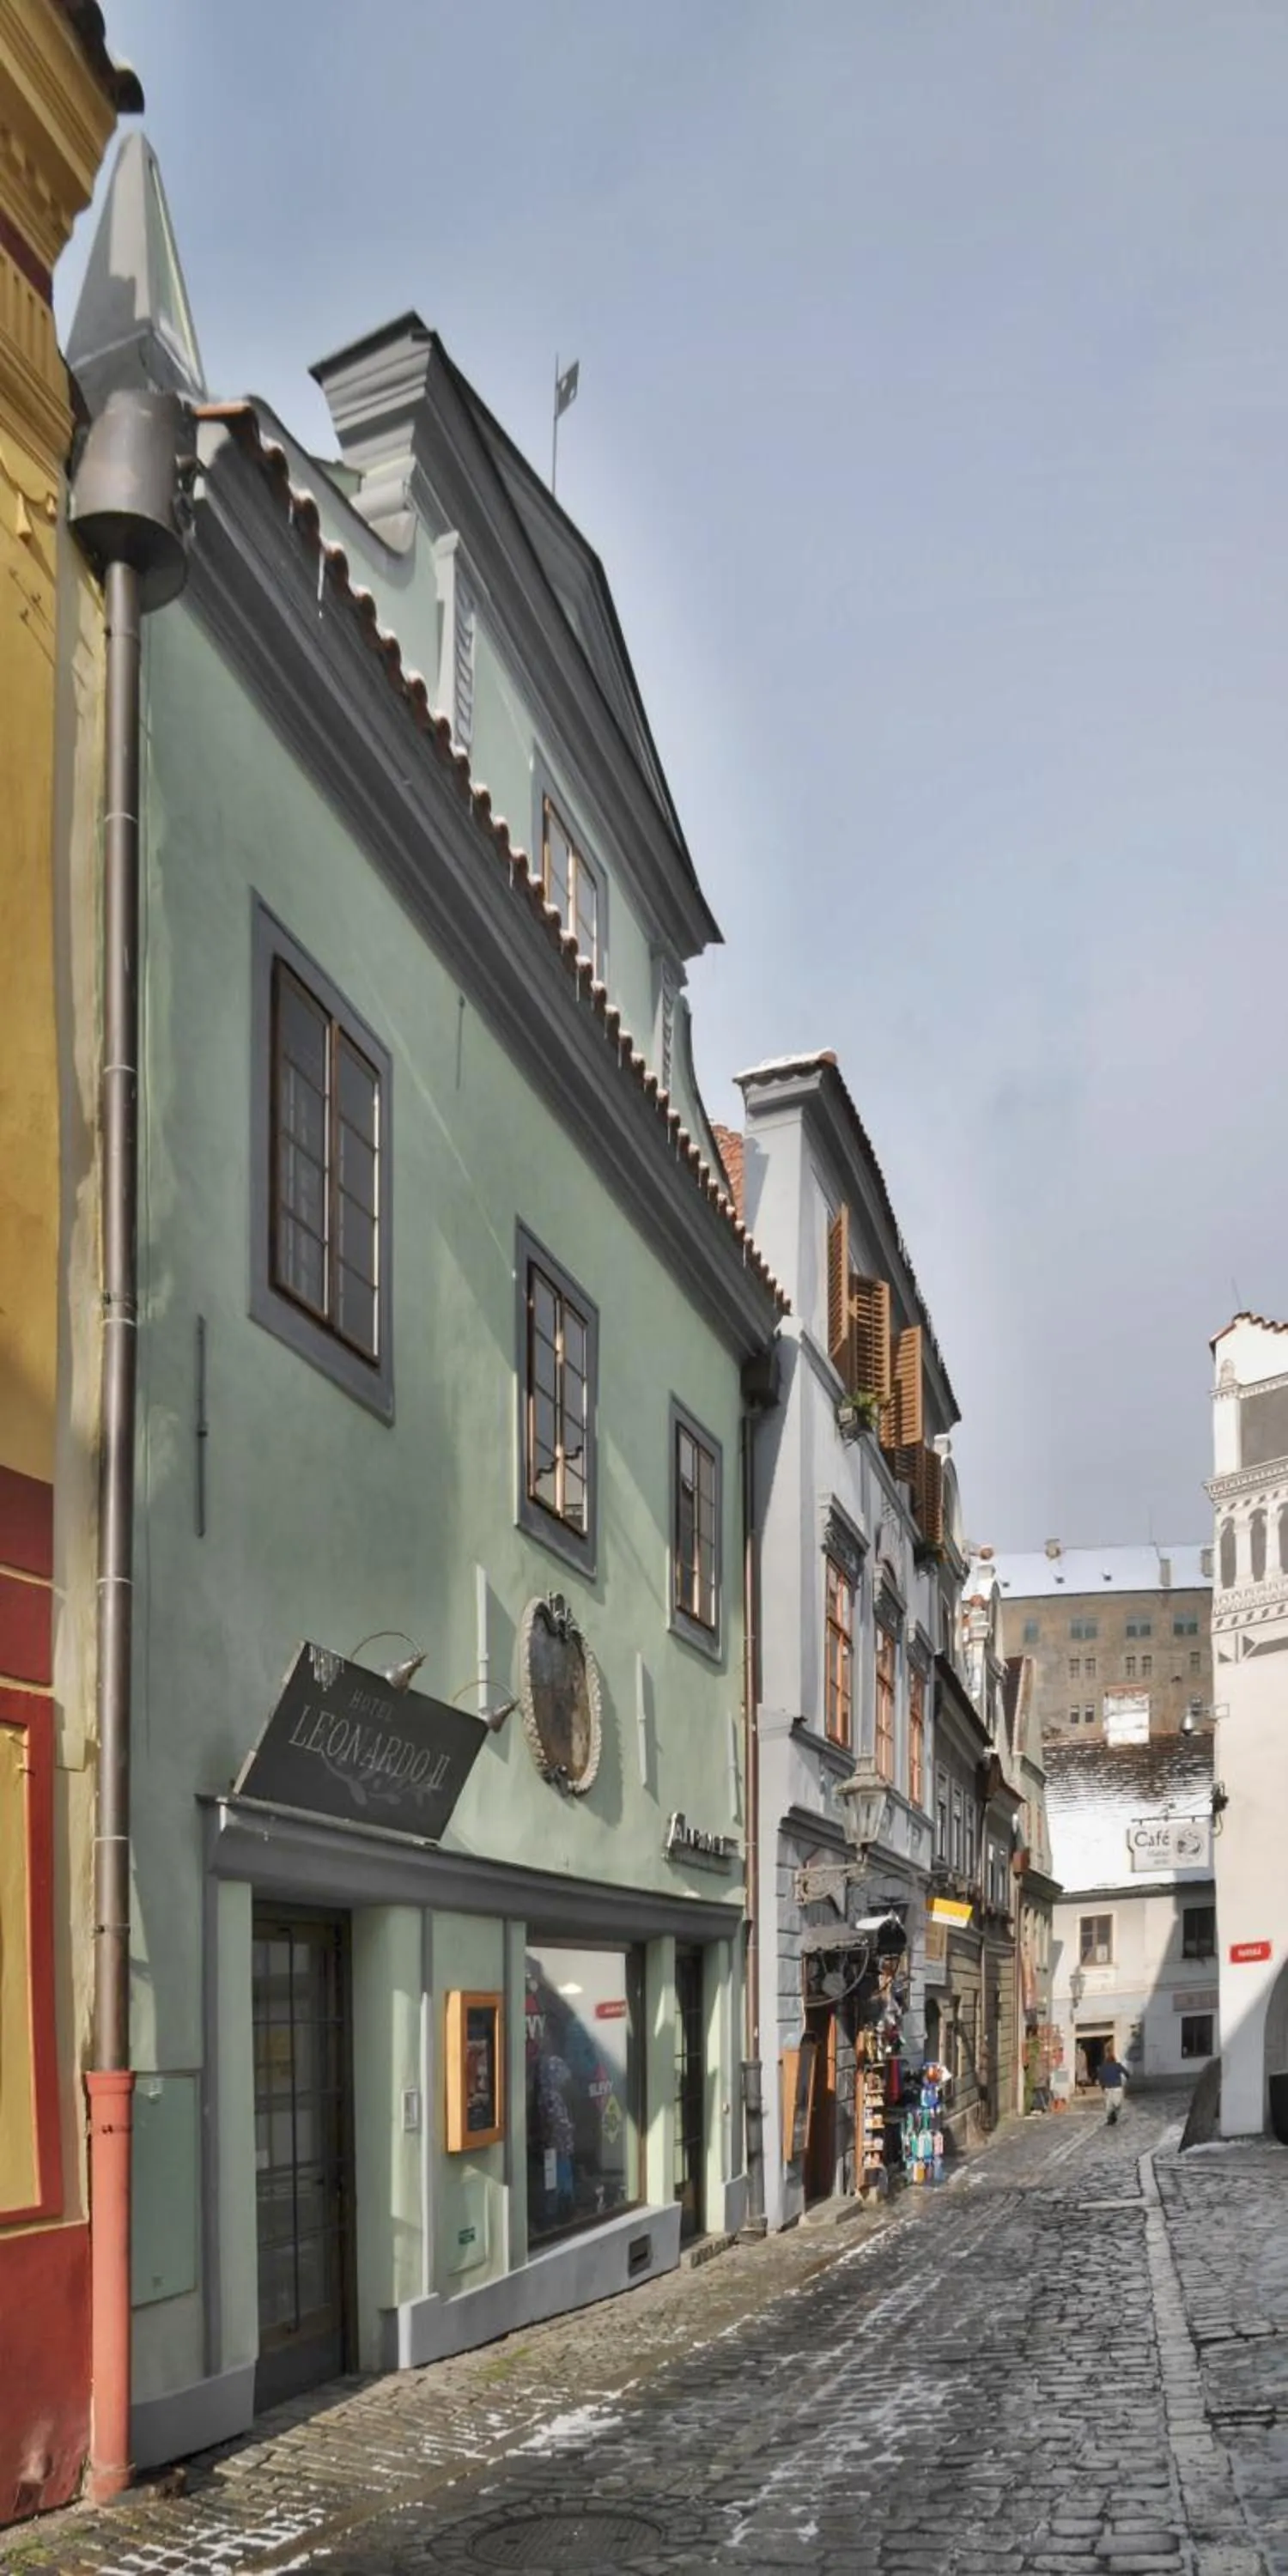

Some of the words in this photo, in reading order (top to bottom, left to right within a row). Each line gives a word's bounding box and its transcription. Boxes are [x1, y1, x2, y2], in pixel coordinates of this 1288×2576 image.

[349, 1689, 395, 1722] HOTEL
[289, 1704, 430, 1782] LEONARDO
[1134, 1831, 1170, 1847] Café
